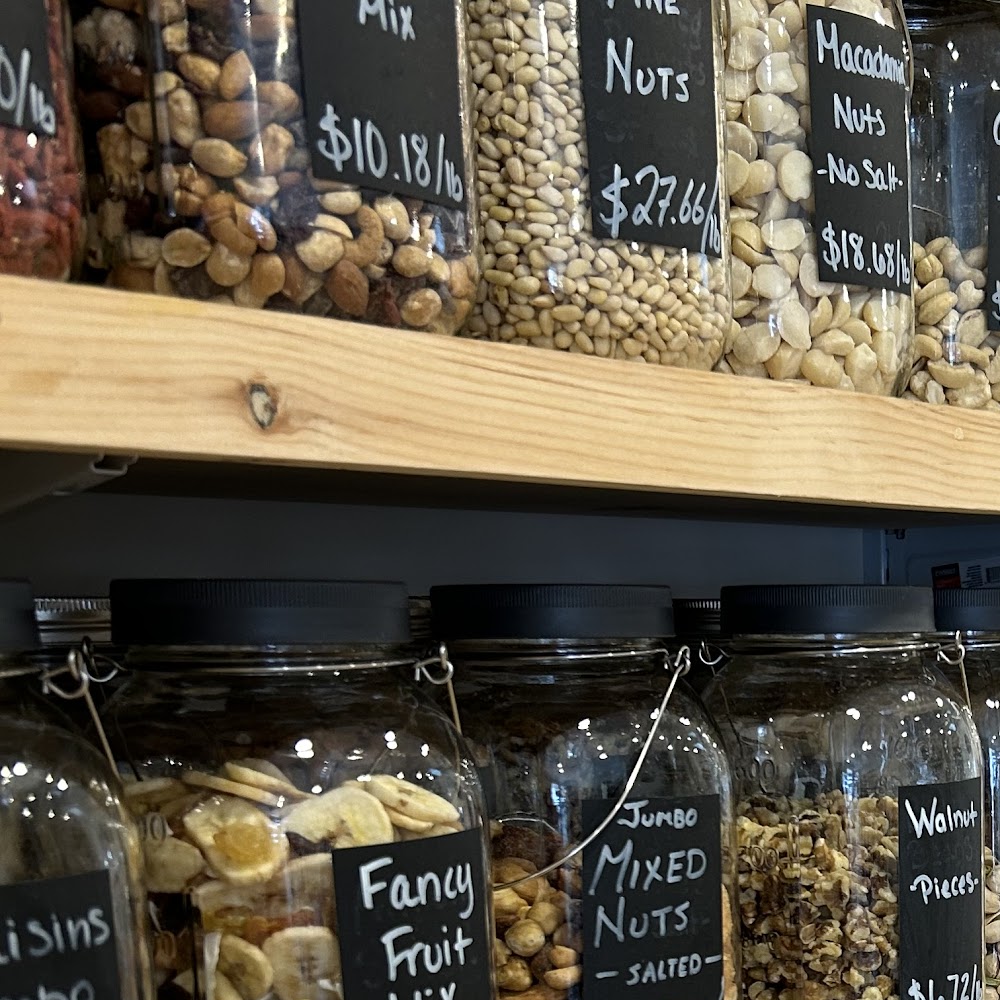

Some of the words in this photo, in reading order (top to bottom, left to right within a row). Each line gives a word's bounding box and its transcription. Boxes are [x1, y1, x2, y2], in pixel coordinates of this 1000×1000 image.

[833, 92, 887, 136] Nuts
[317, 103, 465, 202] $10.18/lb
[904, 796, 978, 839] Walnut
[359, 856, 475, 920] Fancy
[380, 925, 474, 982] Fruit
